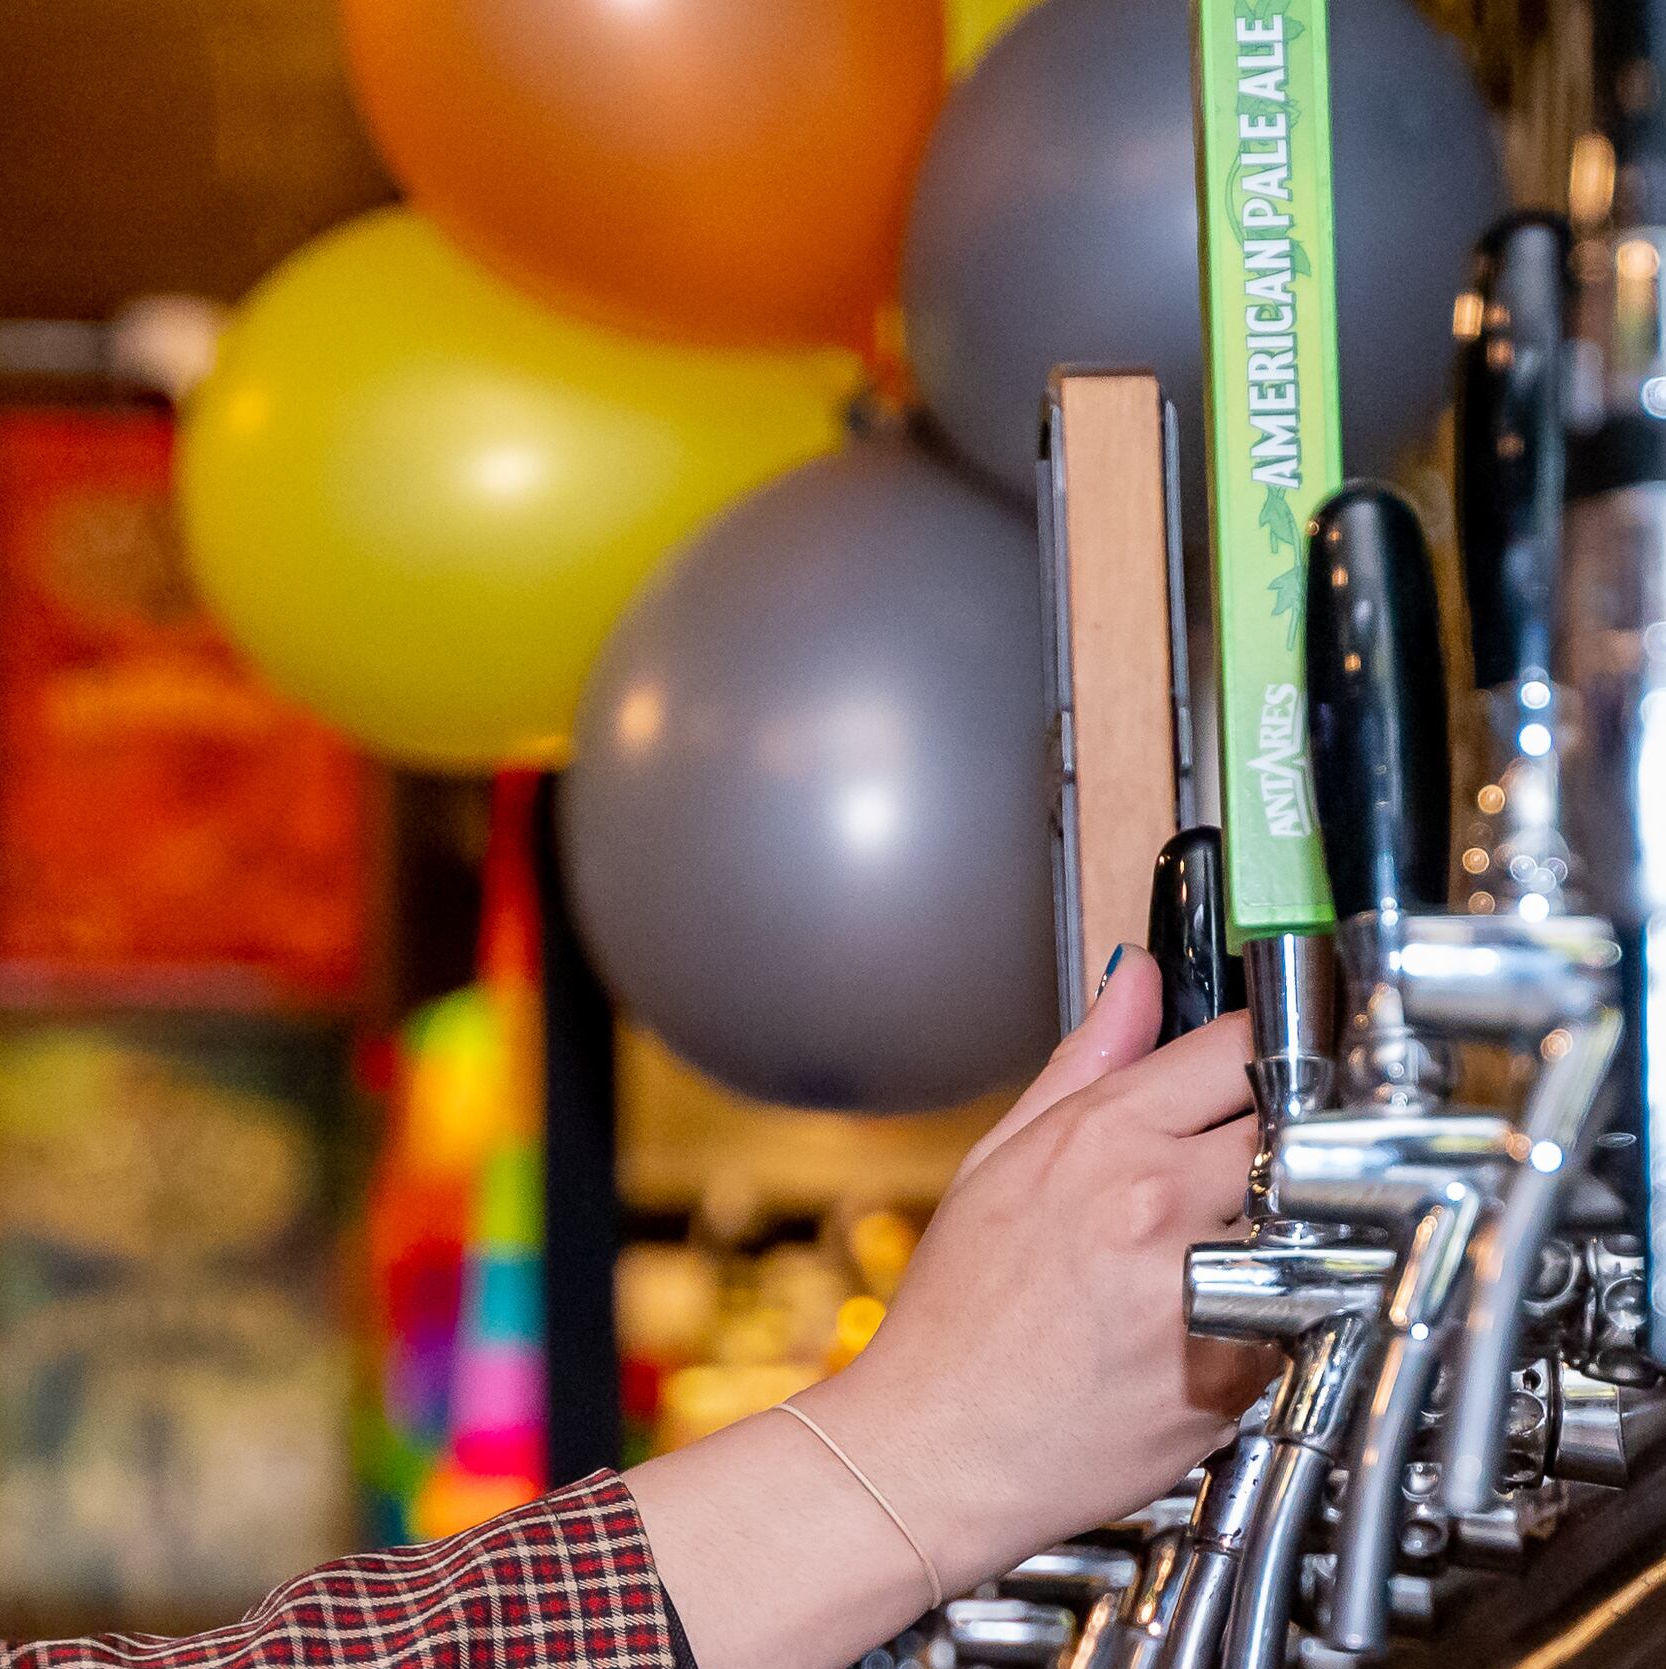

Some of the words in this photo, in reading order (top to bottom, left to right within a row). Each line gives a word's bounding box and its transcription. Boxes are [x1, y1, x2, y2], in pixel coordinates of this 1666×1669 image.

[1235, 14, 1285, 102] ALE
[1238, 112, 1290, 228] PALE
[1245, 238, 1300, 490] AMERICAN
[1246, 683, 1309, 837] ANTARES
